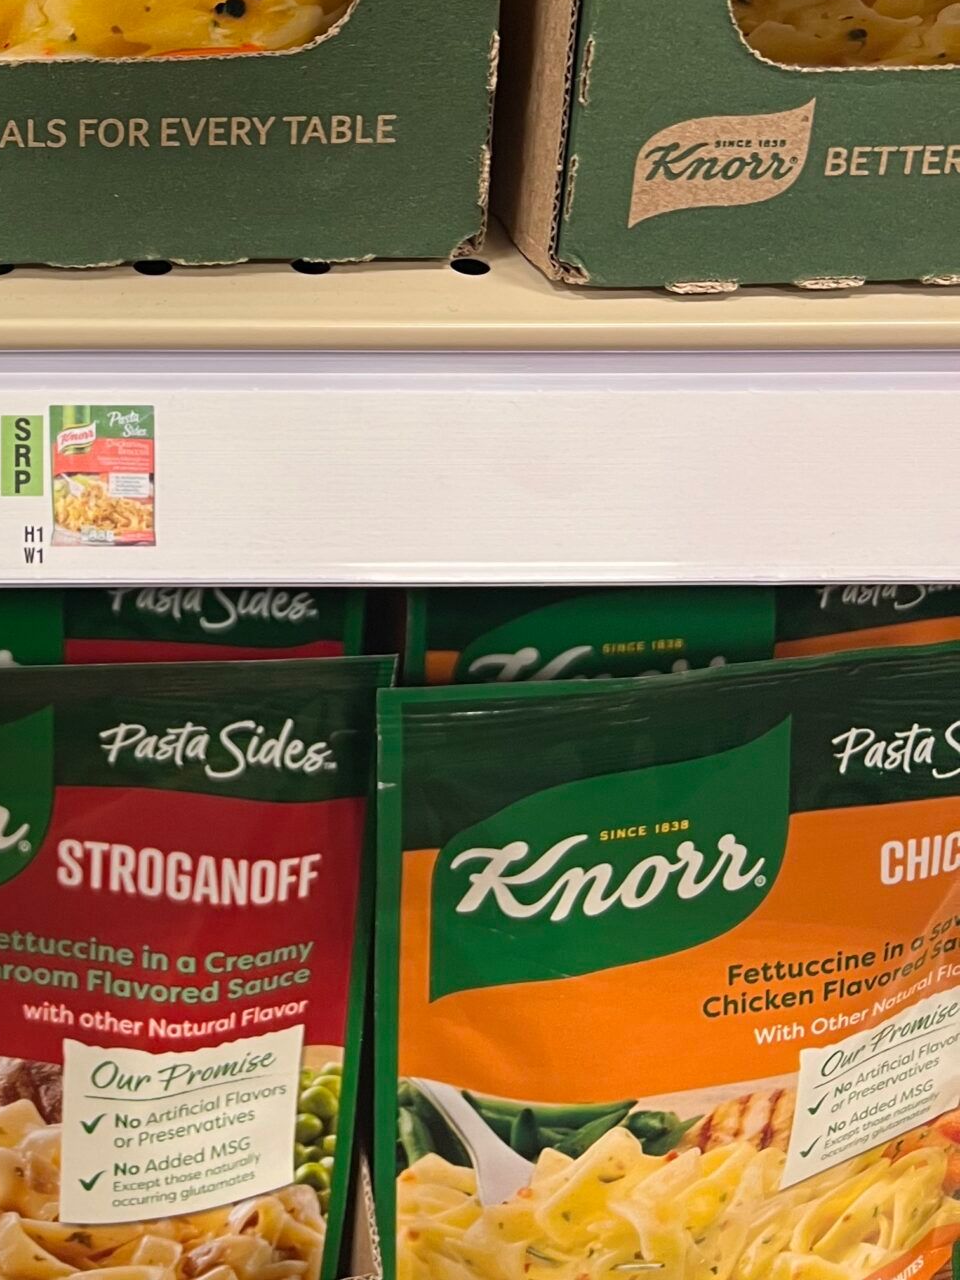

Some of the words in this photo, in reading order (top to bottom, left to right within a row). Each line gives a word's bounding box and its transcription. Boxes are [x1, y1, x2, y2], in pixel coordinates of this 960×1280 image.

[79, 116, 150, 149] FOR
[159, 115, 279, 148] EVERY
[282, 113, 398, 146] TABLE
[24, 525, 44, 543] H1
[24, 546, 44, 564] W1
[100, 720, 211, 768] Pasta
[831, 722, 936, 775] Pasta
[599, 823, 647, 842] SINCE
[654, 819, 690, 836] 1838
[56, 838, 322, 907] STROGANOFF
[204, 939, 314, 975] Creamy
[727, 950, 876, 987] Fettuccine
[86, 973, 220, 1005] Flavored
[226, 965, 311, 1001] Sauce
[702, 988, 814, 1018] Chicken
[823, 948, 928, 1002] Flavored
[23, 1001, 75, 1026] with
[79, 1010, 143, 1037] other
[148, 1012, 236, 1039] Natural
[241, 998, 309, 1023] Flavor
